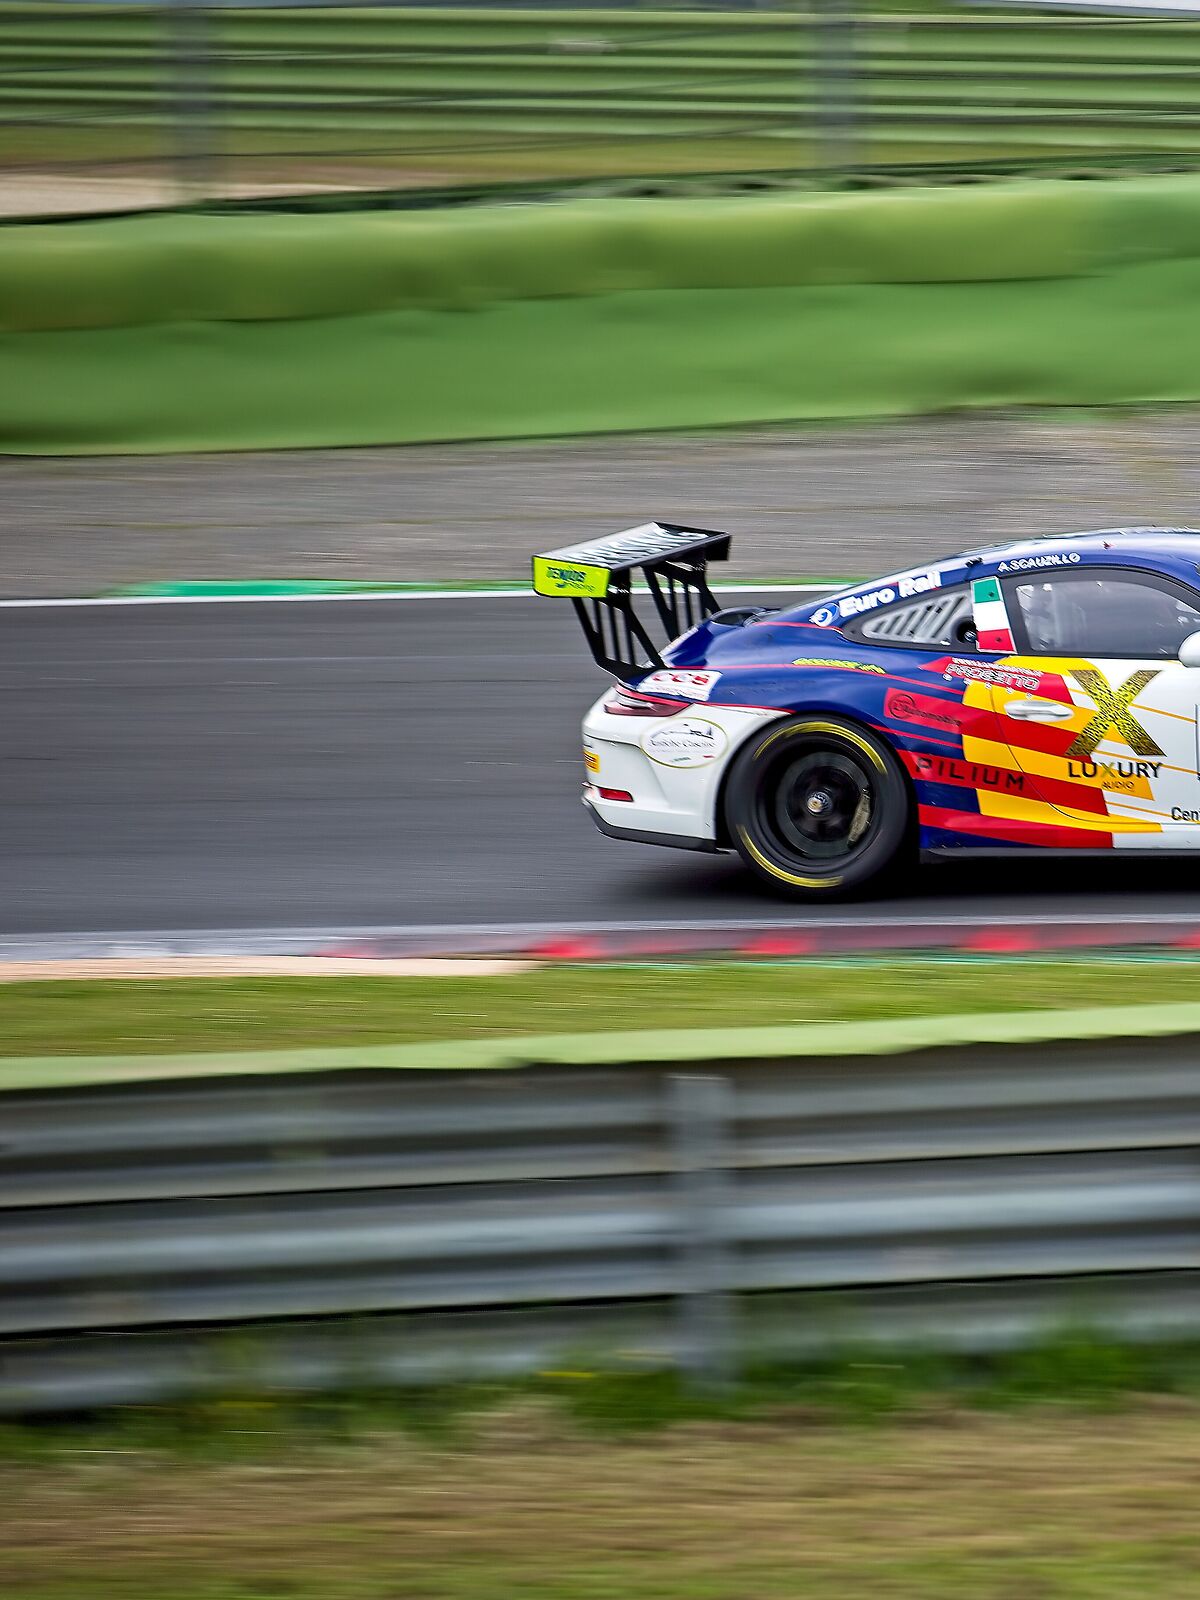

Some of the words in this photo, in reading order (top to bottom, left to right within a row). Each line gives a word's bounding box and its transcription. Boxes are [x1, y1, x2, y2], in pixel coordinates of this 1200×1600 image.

[839, 588, 896, 617] Euro
[915, 757, 1025, 791] PILIUM
[1067, 761, 1163, 779] LUXURY
